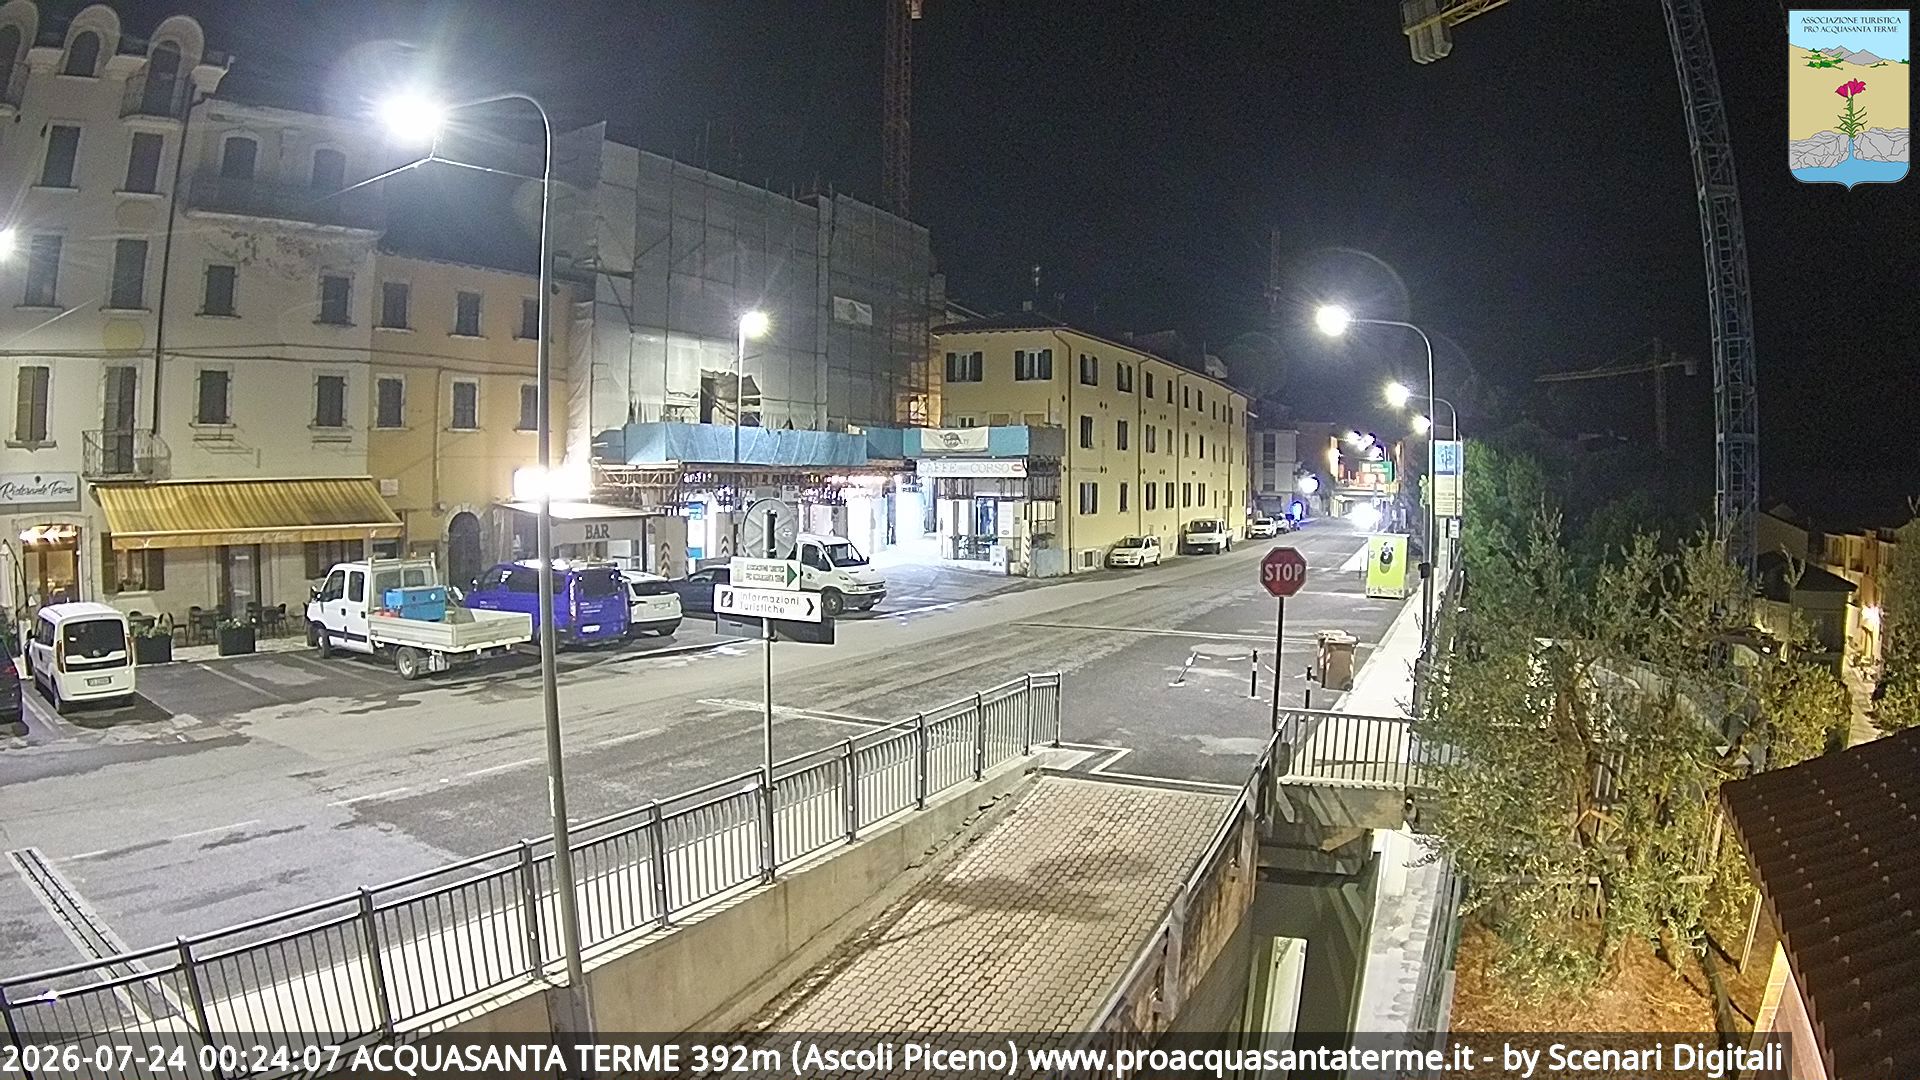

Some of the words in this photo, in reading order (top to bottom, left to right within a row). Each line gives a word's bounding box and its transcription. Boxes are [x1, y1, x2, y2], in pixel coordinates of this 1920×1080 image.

[970, 462, 1010, 474] CORSO
[585, 523, 610, 540] BAR
[1264, 563, 1303, 581] STOP
